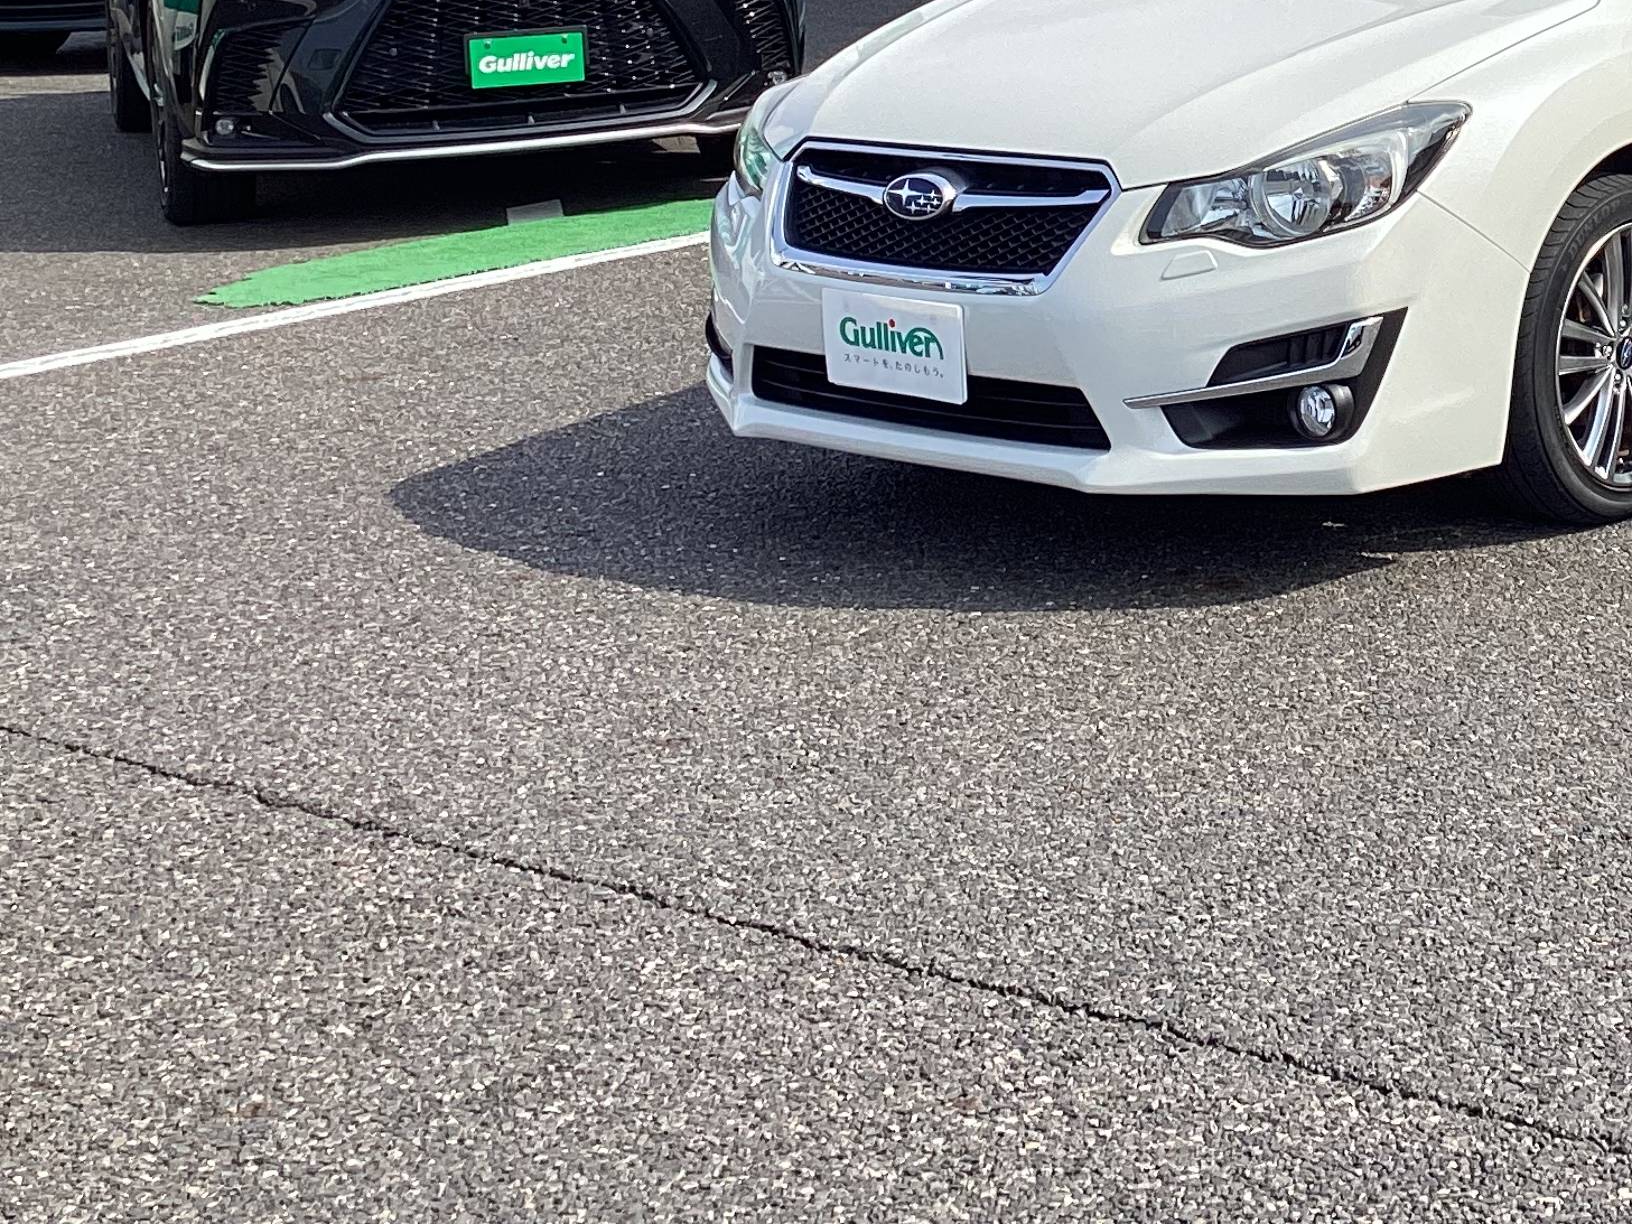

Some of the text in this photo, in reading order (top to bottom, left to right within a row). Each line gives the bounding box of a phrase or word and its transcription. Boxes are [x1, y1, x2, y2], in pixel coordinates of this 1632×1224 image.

[478, 50, 576, 74] Gulliver
[839, 316, 944, 361] Gulliver
[843, 353, 944, 378] スマートを、たのしもう。
